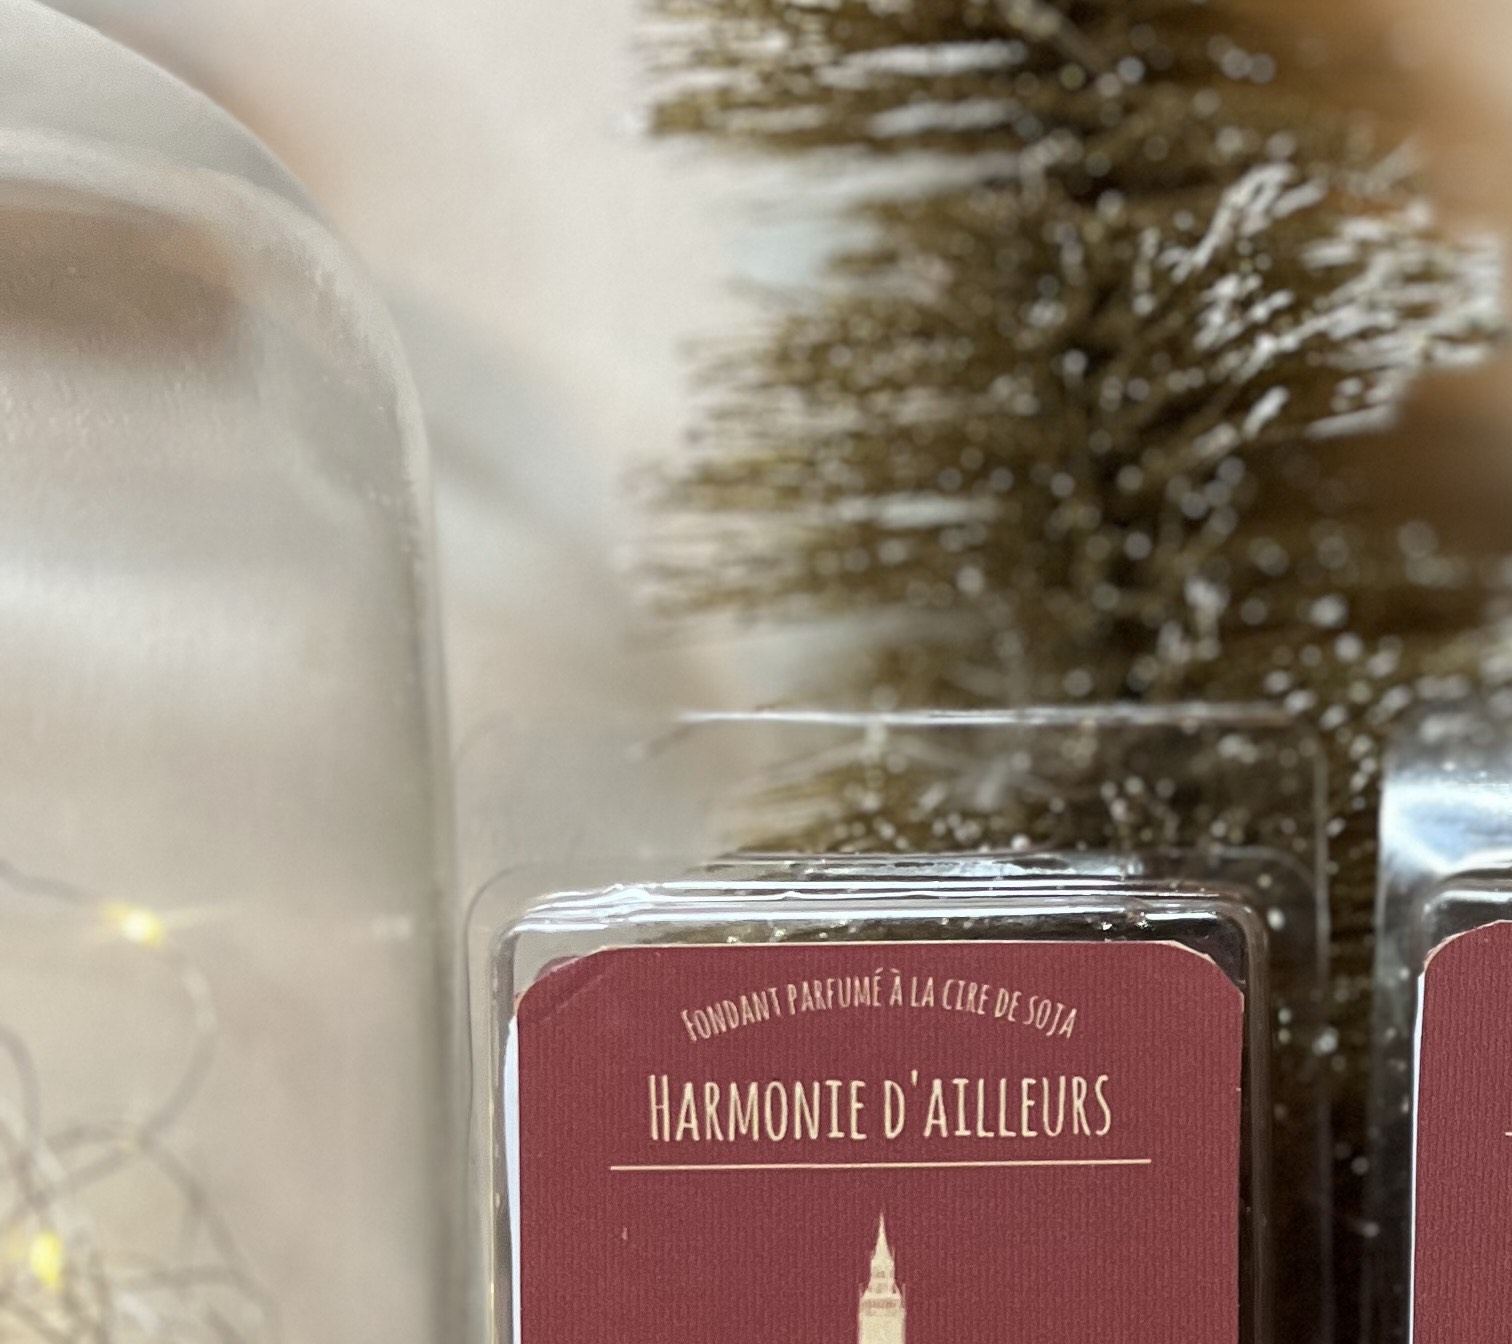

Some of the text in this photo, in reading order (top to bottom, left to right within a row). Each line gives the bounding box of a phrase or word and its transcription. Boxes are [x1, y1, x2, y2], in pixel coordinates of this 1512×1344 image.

[680, 966, 1078, 1042] FONDANT PARFUMÉ À LA CIRE DE SOJA
[648, 1069, 1112, 1142] HARMONIE D'AILLEURS
